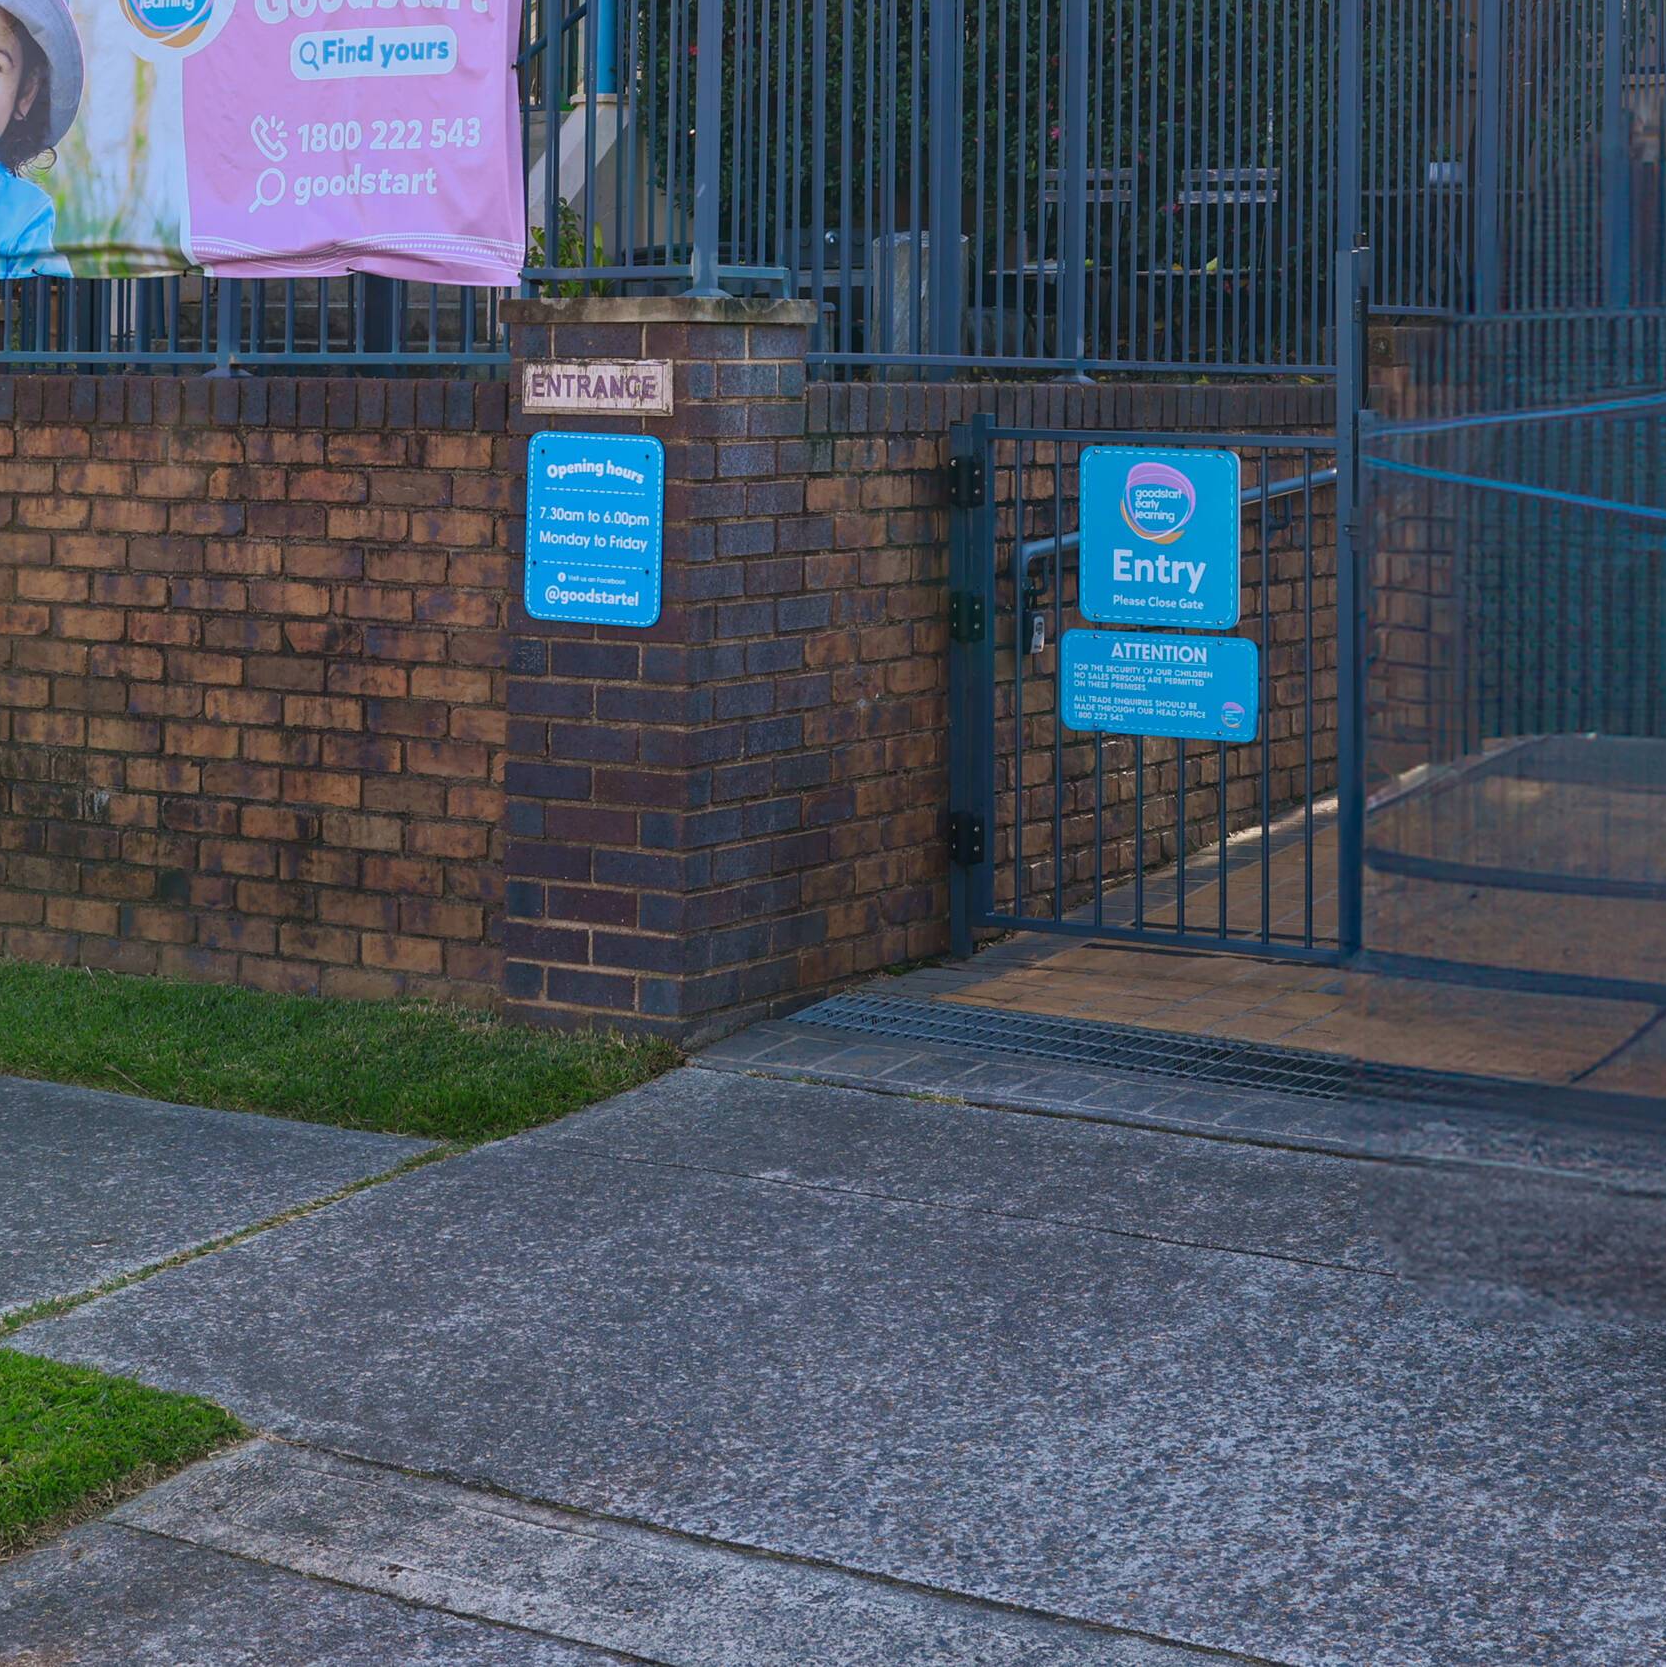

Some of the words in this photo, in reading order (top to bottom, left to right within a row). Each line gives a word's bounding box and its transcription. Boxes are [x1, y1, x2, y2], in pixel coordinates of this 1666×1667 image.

[322, 36, 374, 66] Find
[380, 37, 450, 69] yours
[296, 120, 362, 153] 1800
[371, 119, 422, 151] 222
[429, 118, 482, 149] 543
[293, 164, 438, 206] goodstart
[531, 374, 658, 400] ENTRANCE
[546, 458, 604, 479] Opening
[606, 459, 645, 484] hours
[1134, 488, 1182, 500] goodstart
[1134, 498, 1160, 511] early
[539, 506, 585, 523] 7.30am
[588, 509, 600, 523] to
[603, 511, 649, 528] 6.00pm
[1134, 509, 1176, 523] learning
[539, 530, 590, 549] Monday
[594, 534, 607, 548] to
[609, 535, 648, 553] Friday
[1113, 548, 1206, 594] Entry
[545, 585, 639, 607] @goodstartel
[1113, 594, 1147, 607] Please
[1148, 596, 1177, 609] Close
[1179, 597, 1204, 610] Gate
[1111, 642, 1208, 663] ATTENTION
[1073, 663, 1089, 671] FOR
[1090, 664, 1103, 672] THE
[1106, 665, 1140, 674] SECURITY
[1143, 667, 1154, 675] OF
[1155, 668, 1172, 676] OUR
[1174, 669, 1213, 679] CHILDREN
[1074, 671, 1086, 679] NO
[1088, 672, 1110, 680] SALES
[1111, 674, 1146, 683] PERSONS
[1147, 676, 1162, 684] ARE
[1164, 677, 1205, 687] PERMITTED
[1074, 679, 1086, 687] ON
[1088, 681, 1109, 689] THESE
[1074, 694, 1086, 702] ALL
[1088, 695, 1112, 704] TRADE
[1114, 696, 1153, 707] ENQUIRIES
[1155, 700, 1187, 709] SHOULD
[1188, 702, 1198, 710] BE
[1074, 703, 1095, 711] MADE
[1097, 704, 1136, 713] THROUGH
[1137, 706, 1154, 715] OUR
[1155, 708, 1177, 717] HEAD
[1179, 710, 1206, 719] OFFICE
[1075, 711, 1092, 719] 1800
[1094, 713, 1108, 721] 222
